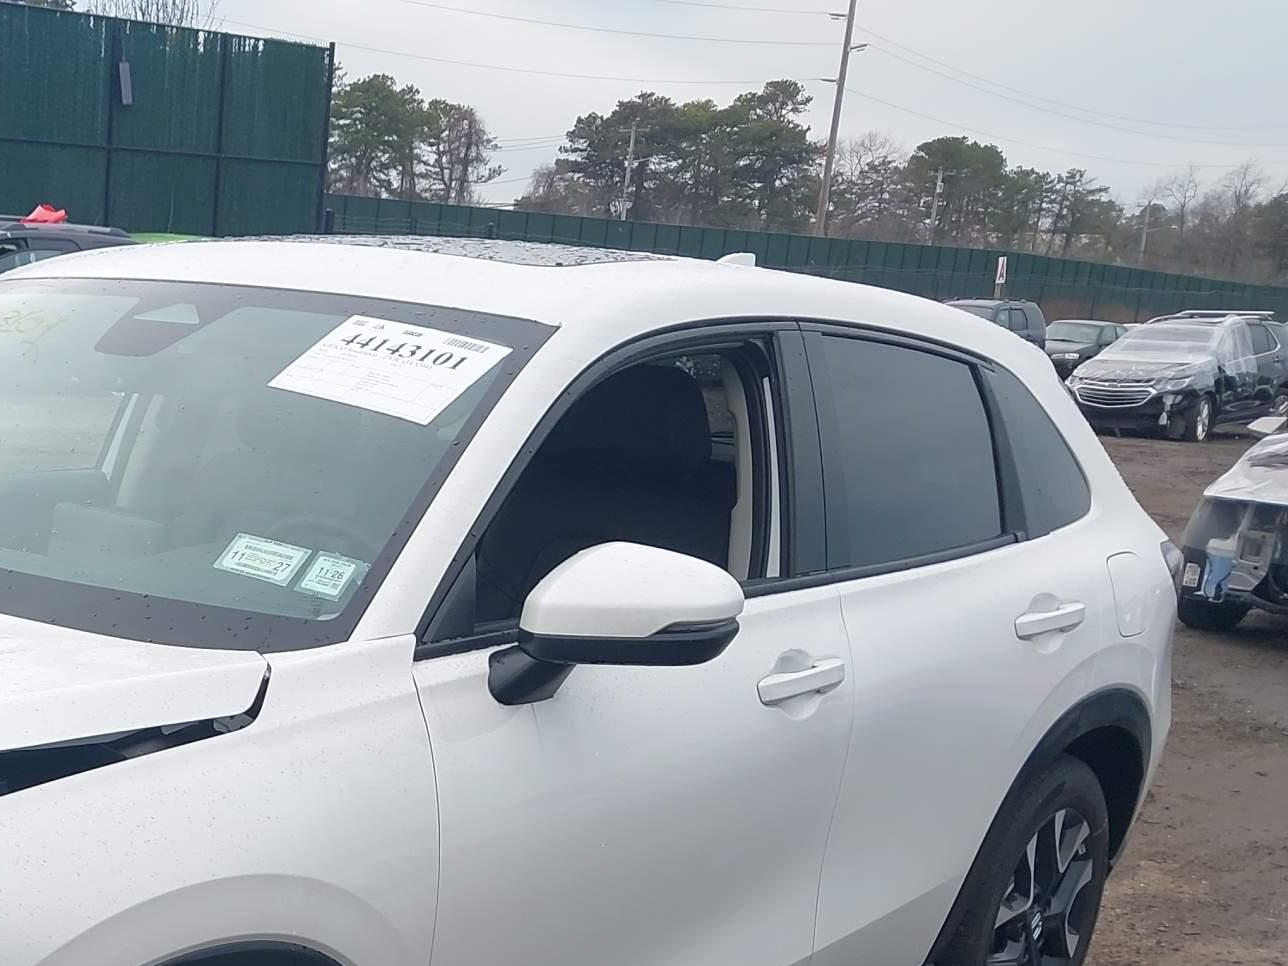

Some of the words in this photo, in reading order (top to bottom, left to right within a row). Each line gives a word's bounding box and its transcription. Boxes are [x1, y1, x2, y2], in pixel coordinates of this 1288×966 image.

[341, 332, 469, 371] 44143101
[231, 550, 247, 562] 11
[273, 561, 292, 573] 27
